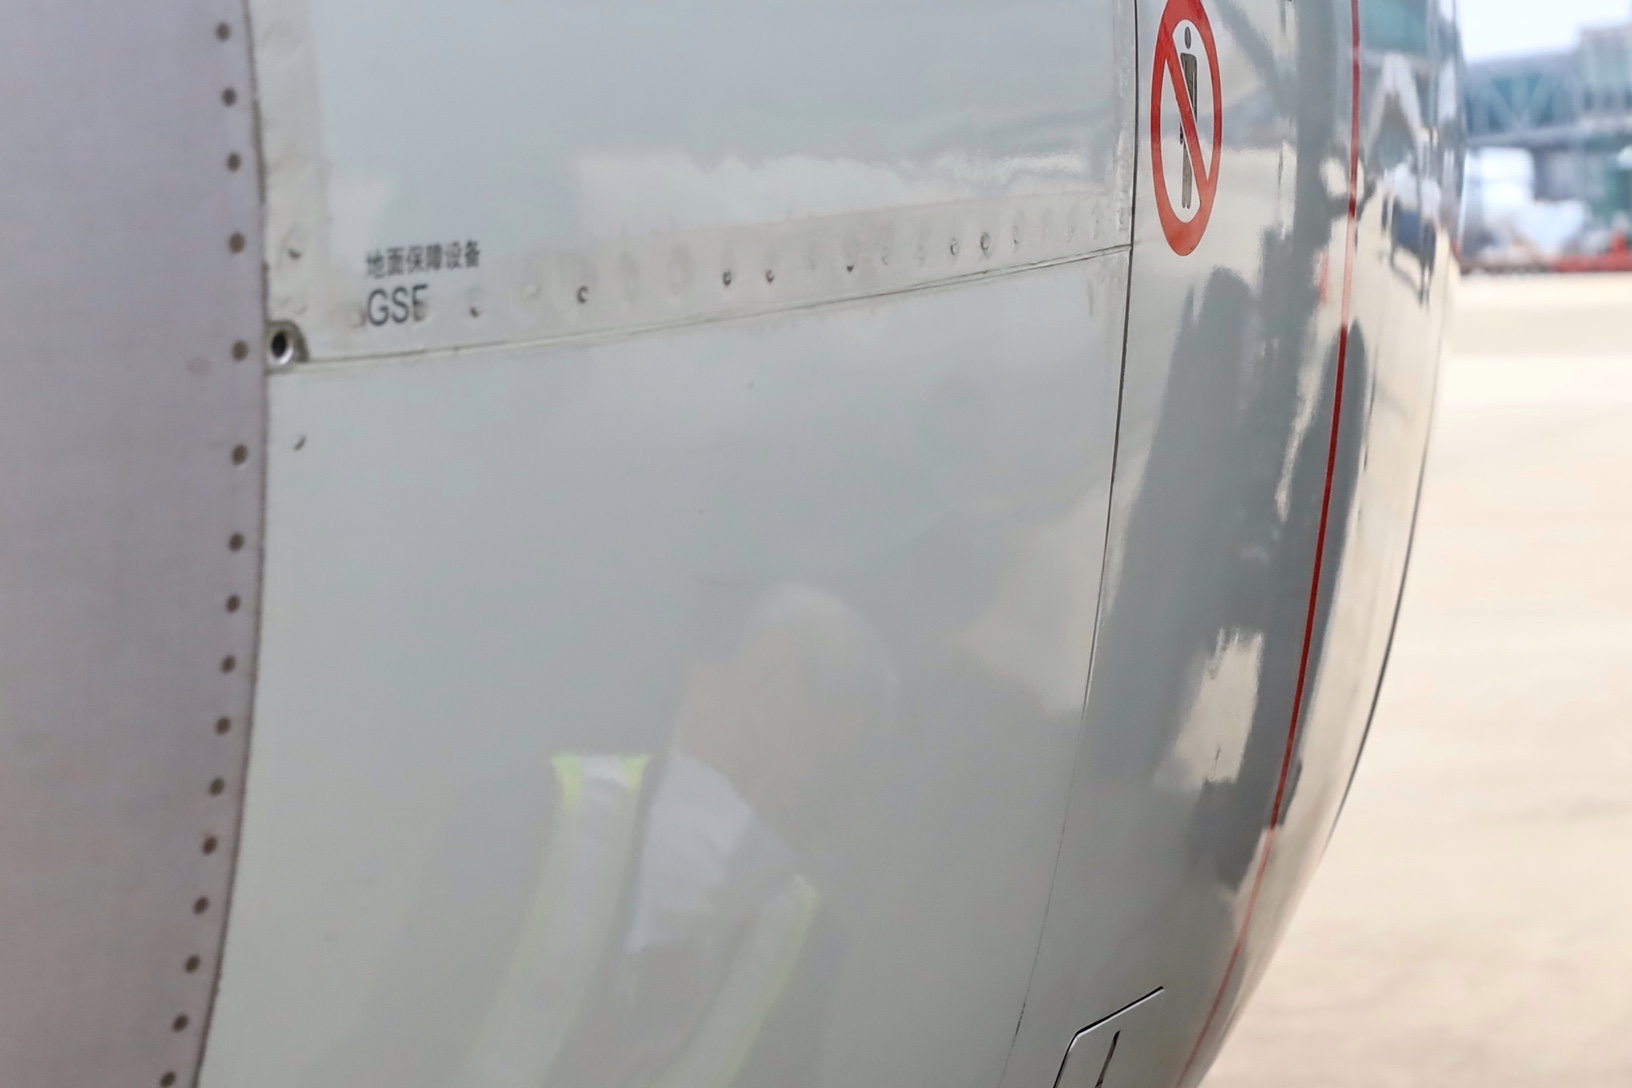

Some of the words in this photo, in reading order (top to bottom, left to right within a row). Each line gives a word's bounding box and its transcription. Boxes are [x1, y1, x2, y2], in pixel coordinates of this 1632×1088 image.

[366, 239, 480, 279] 地面保障设备
[367, 283, 428, 327] GSE
